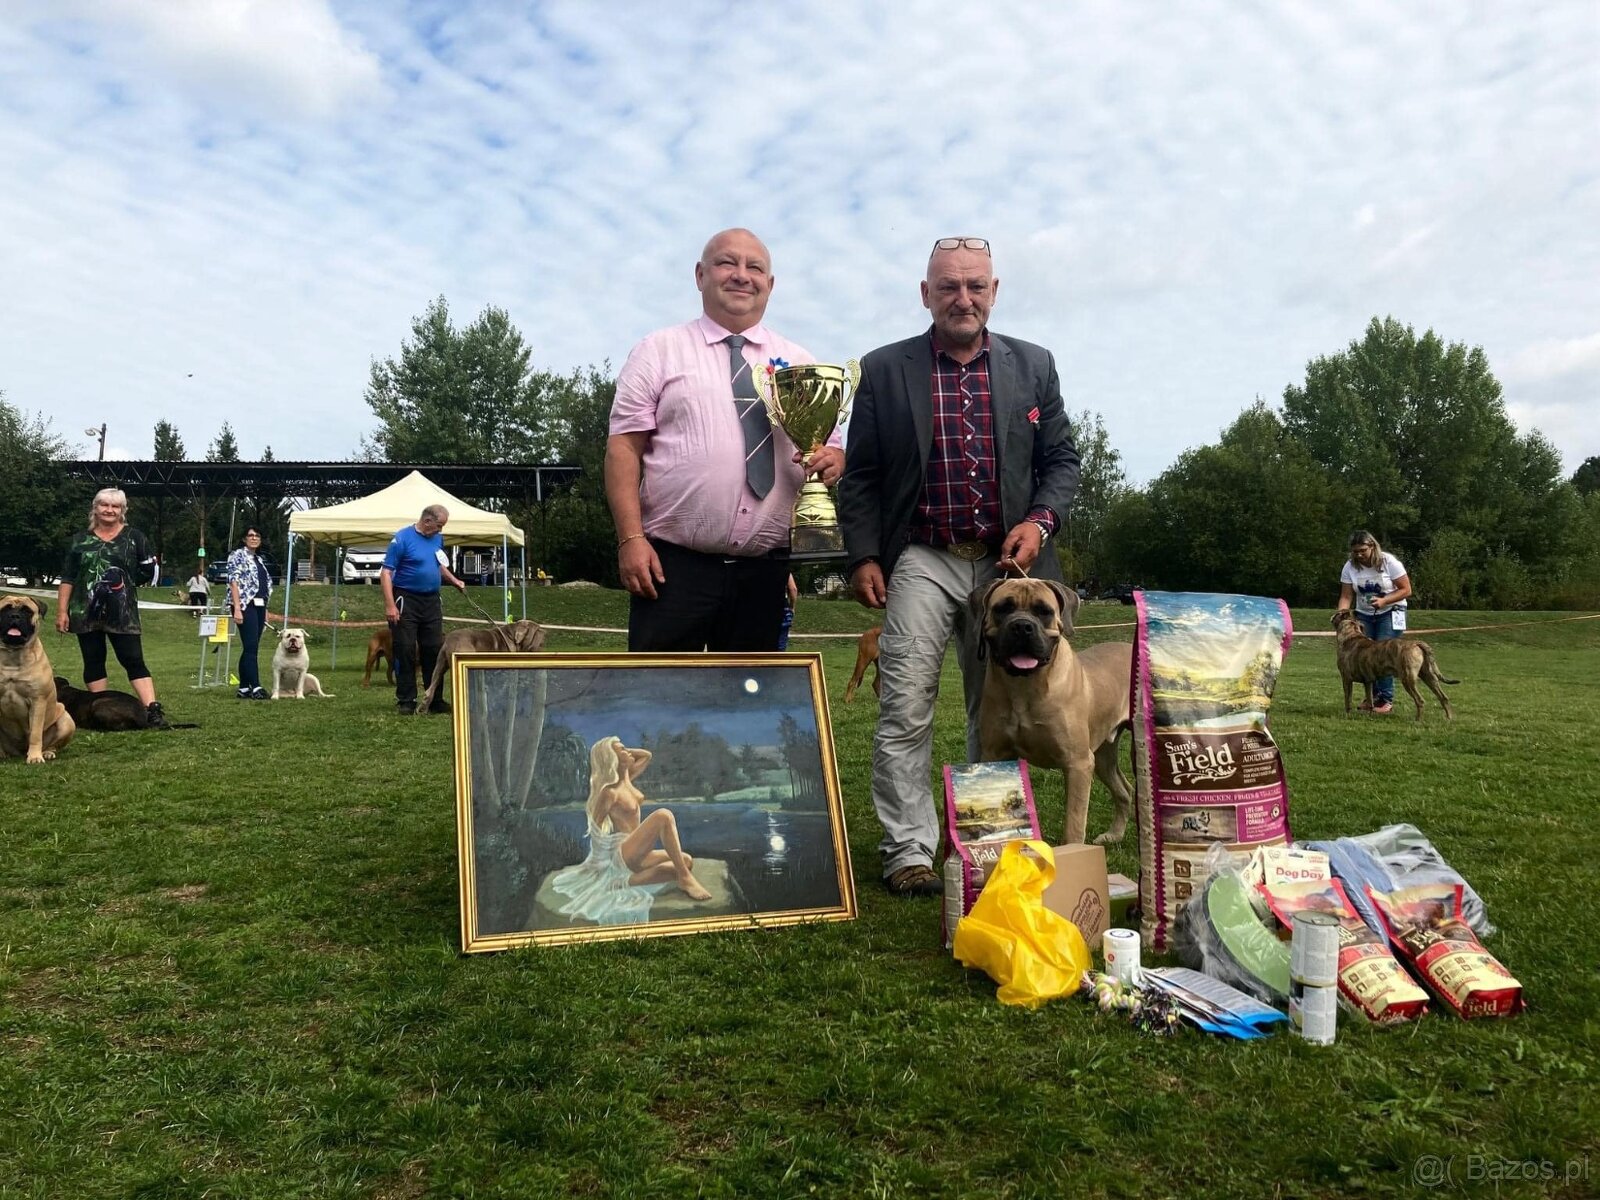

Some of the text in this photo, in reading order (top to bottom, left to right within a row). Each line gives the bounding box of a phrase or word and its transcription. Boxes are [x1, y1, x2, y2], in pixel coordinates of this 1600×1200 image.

[1165, 741, 1197, 753] Sam's
[1167, 743, 1235, 775] Field
[1276, 867, 1299, 879] Dog
[1301, 869, 1325, 880] Day
